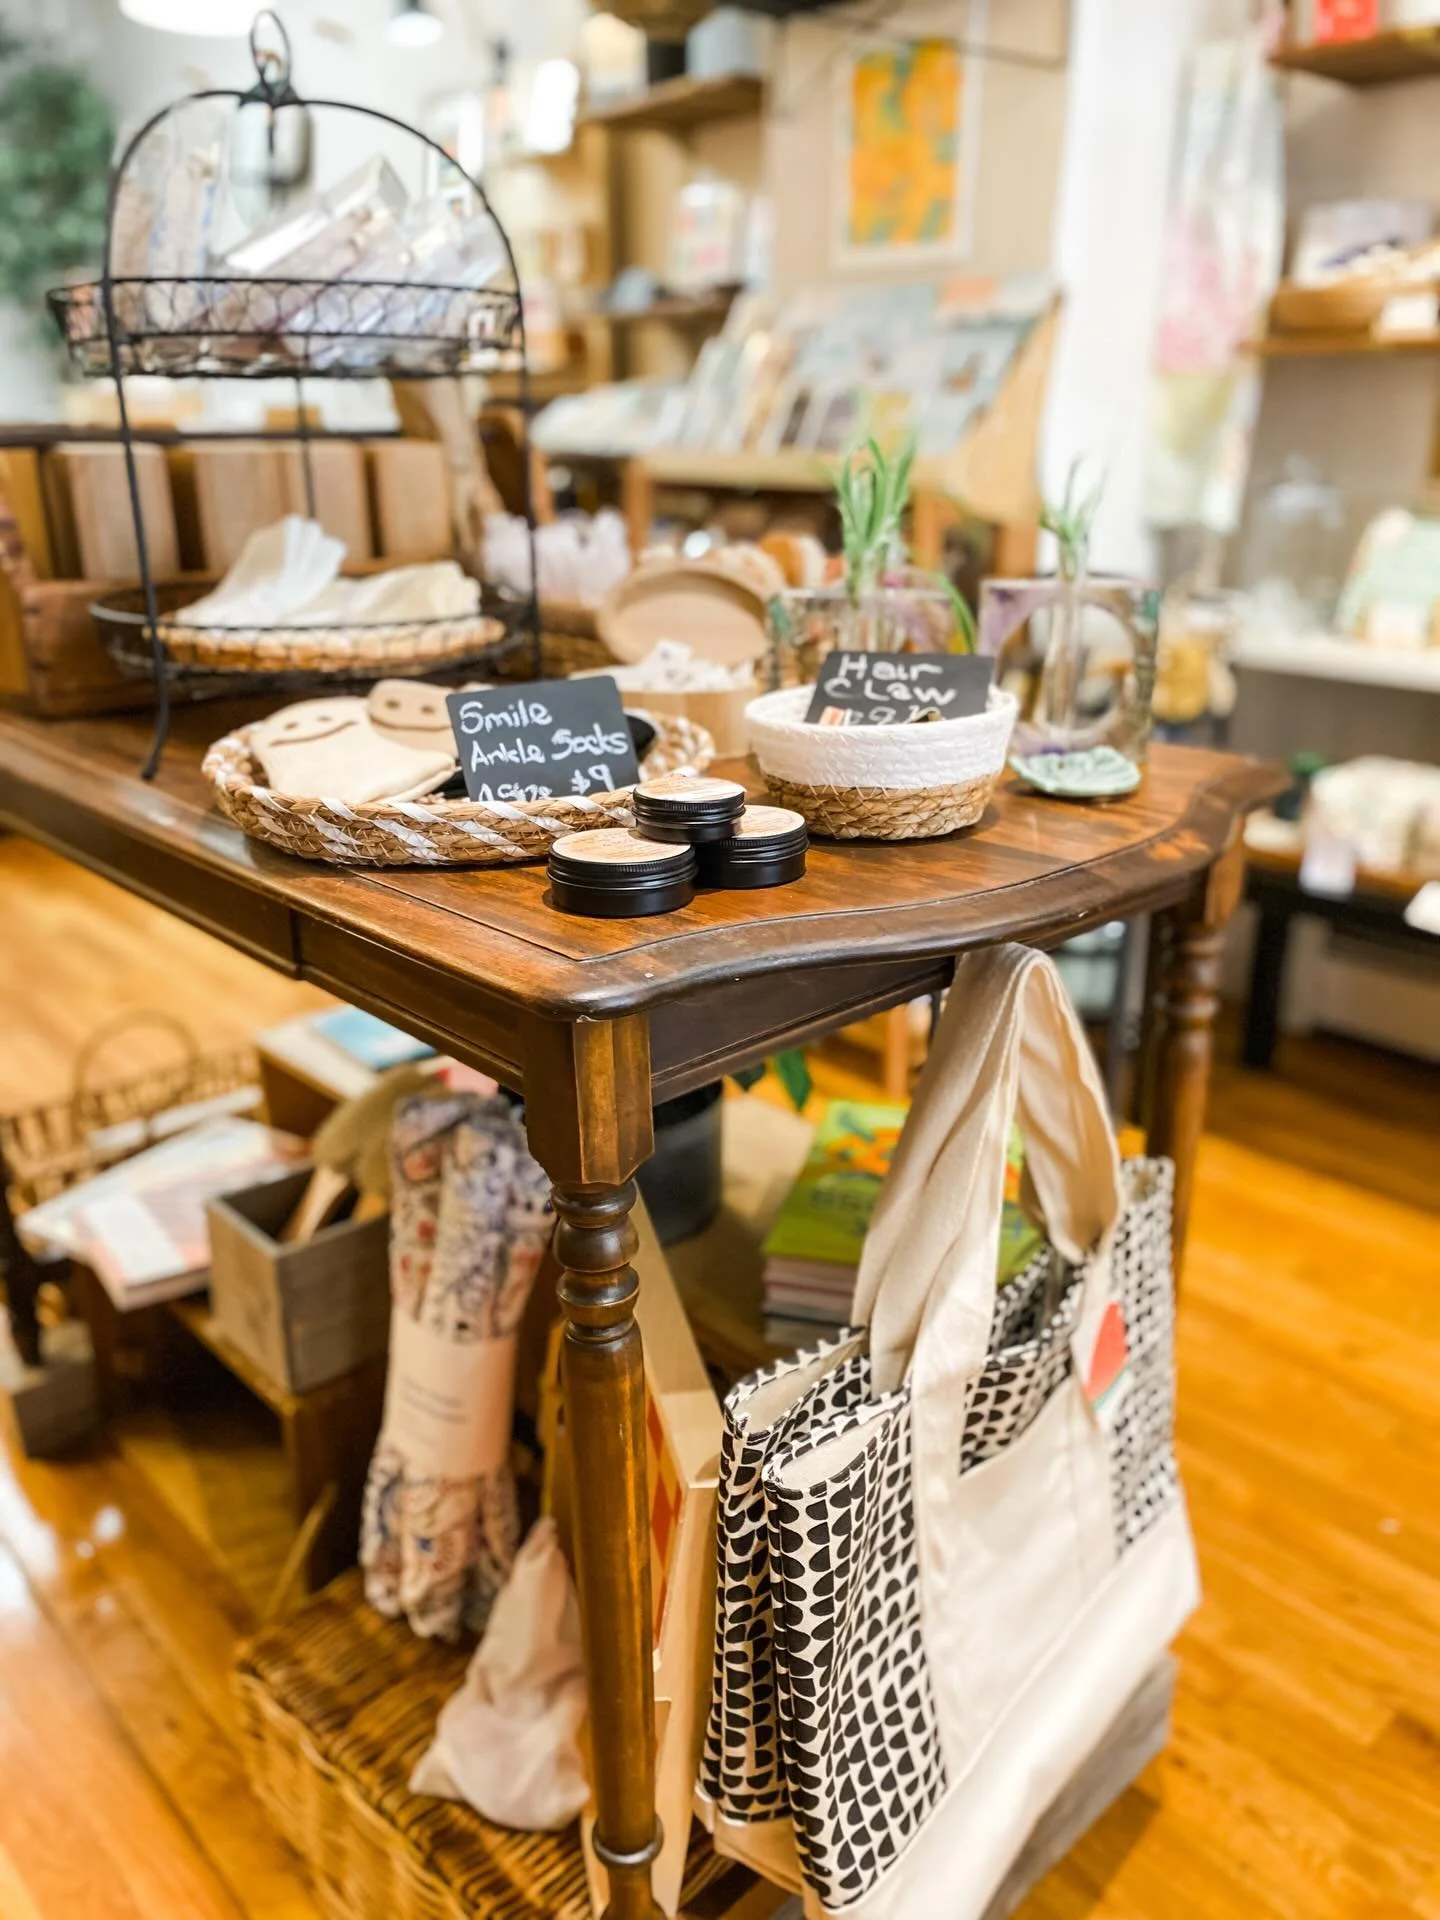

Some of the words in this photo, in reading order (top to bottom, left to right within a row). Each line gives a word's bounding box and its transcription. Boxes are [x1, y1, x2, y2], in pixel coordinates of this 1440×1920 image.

[838, 653, 943, 681] Hair
[459, 697, 553, 734] Smile
[470, 738, 546, 773] Ankle
[550, 722, 629, 761] Socks
[569, 763, 616, 796] $9
